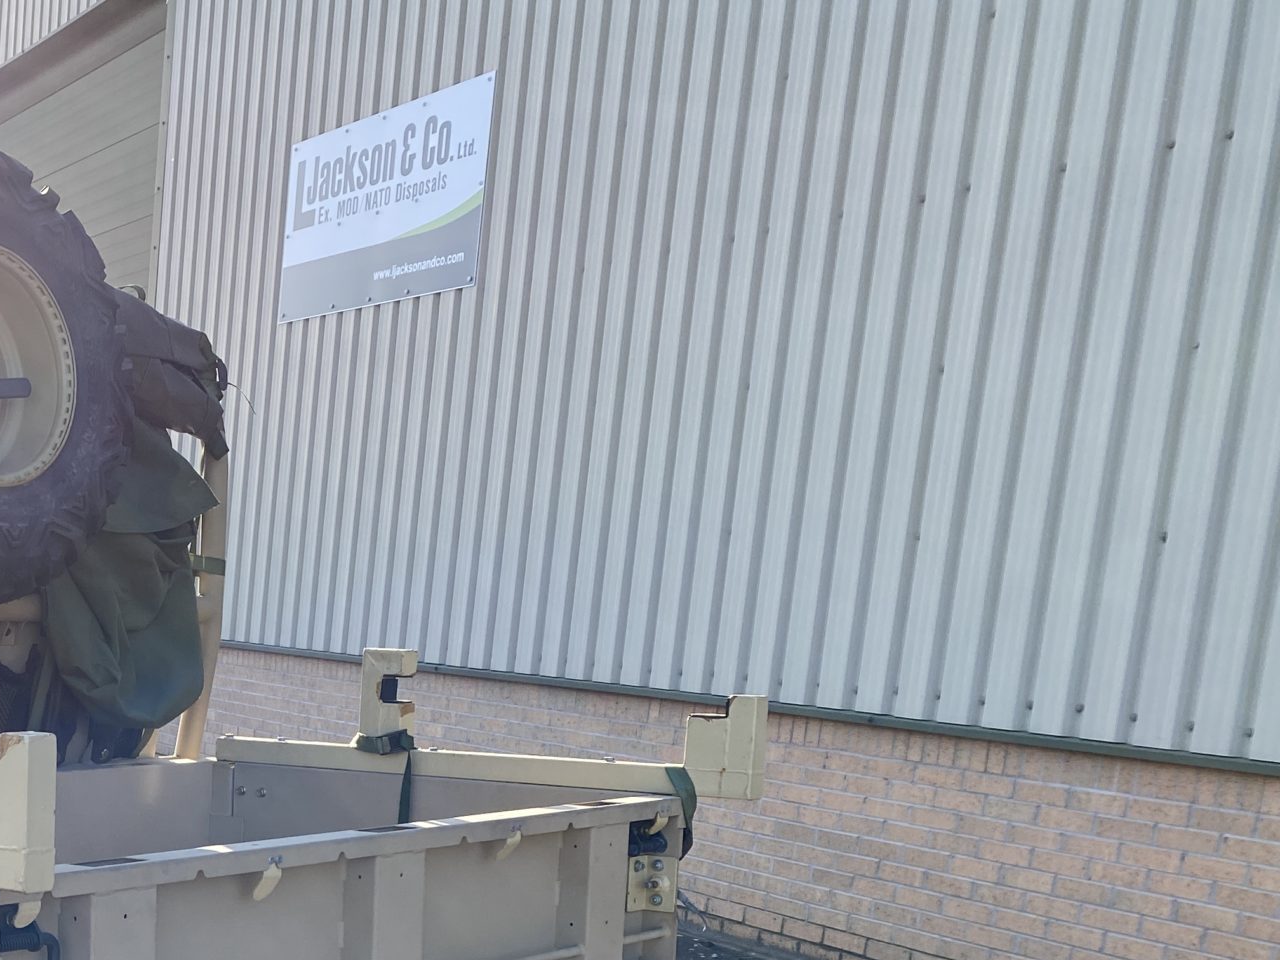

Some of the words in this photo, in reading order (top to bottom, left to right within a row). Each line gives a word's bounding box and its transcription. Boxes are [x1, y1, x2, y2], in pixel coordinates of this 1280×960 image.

[401, 123, 417, 177] &
[421, 115, 454, 171] Co.
[457, 138, 477, 160] Ltd.
[318, 206, 332, 225] Ex.
[395, 171, 447, 203] Disposals
